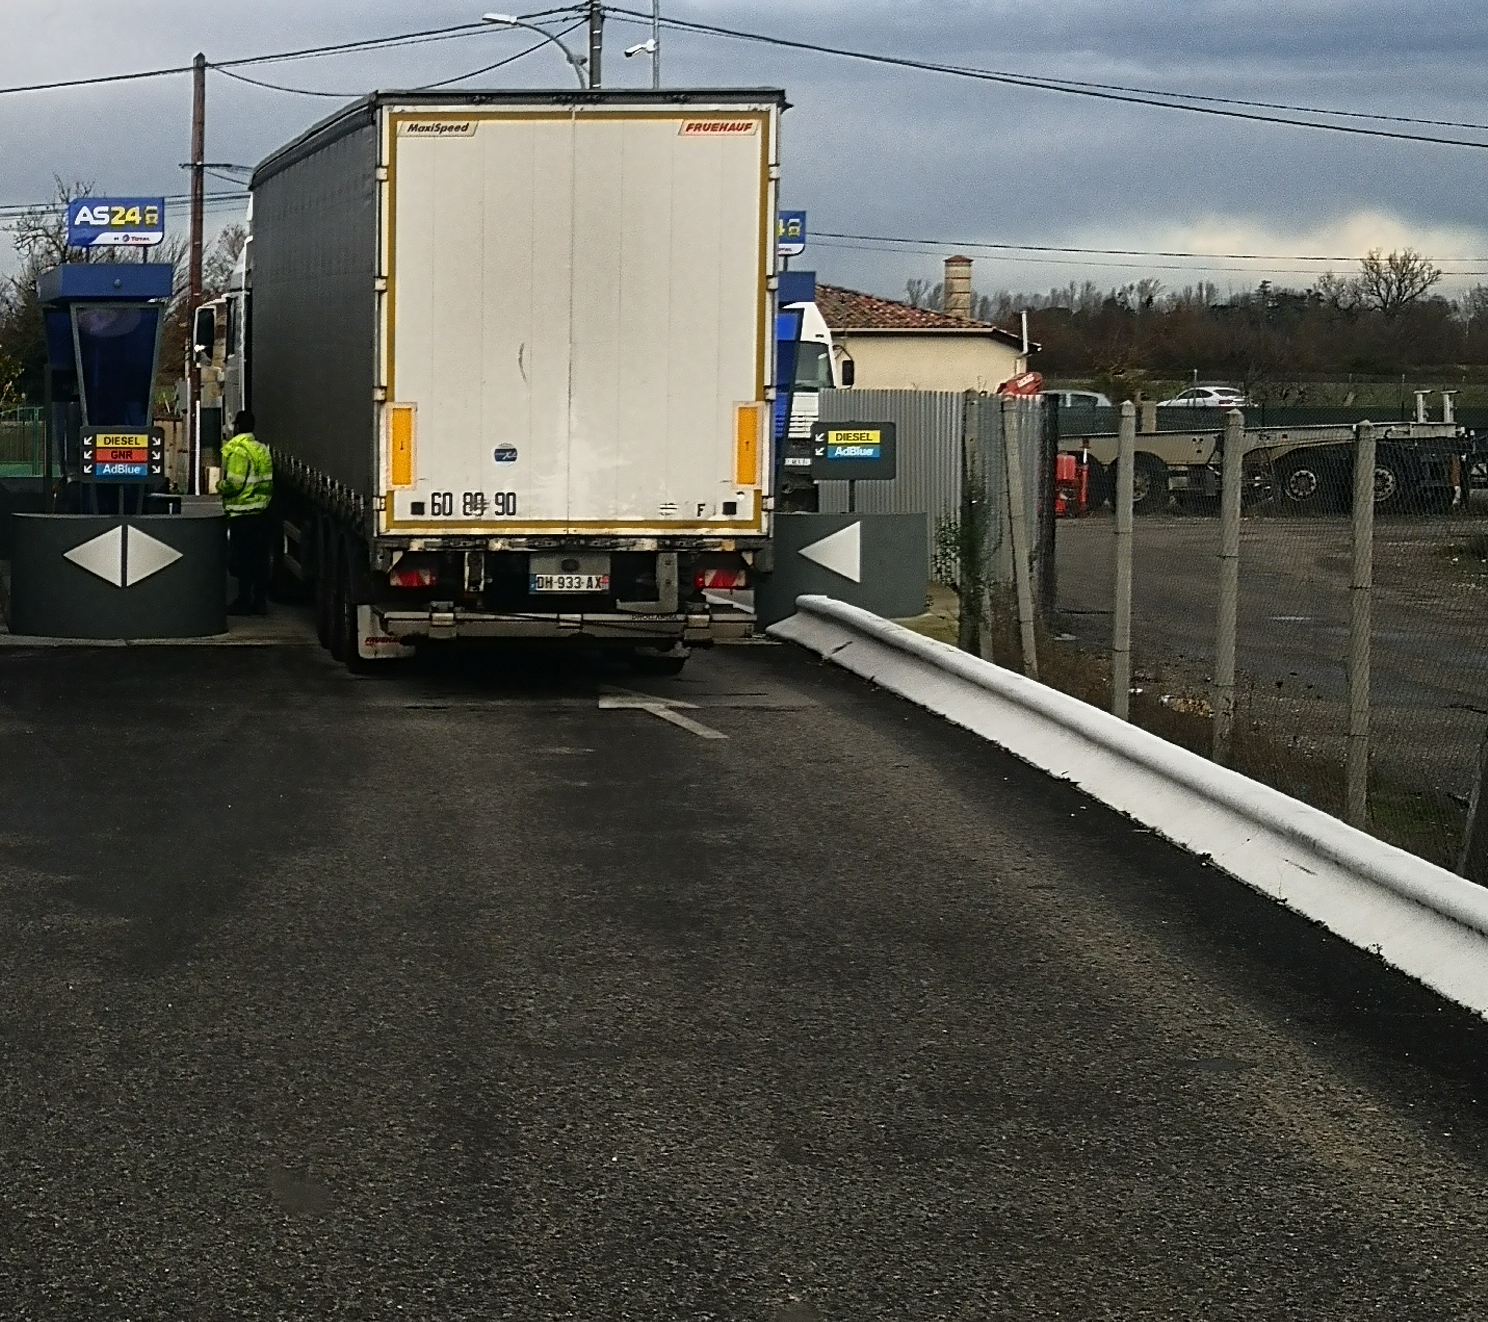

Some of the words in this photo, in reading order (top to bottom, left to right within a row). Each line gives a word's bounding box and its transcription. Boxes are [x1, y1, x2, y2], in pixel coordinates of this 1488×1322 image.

[406, 122, 470, 135] MaxiSpeed
[685, 122, 753, 132] FRUEHAUF
[74, 205, 142, 226] AS24
[103, 436, 141, 446] DIESEL
[835, 432, 873, 442] DIESEL
[110, 450, 133, 460] GNR
[834, 446, 874, 457] AdBlue
[102, 463, 141, 474] AdBlue
[431, 492, 453, 516] 60
[463, 492, 485, 517] 80
[494, 492, 517, 516] 90
[697, 503, 706, 517] F
[536, 576, 602, 589] DH-933-AX
